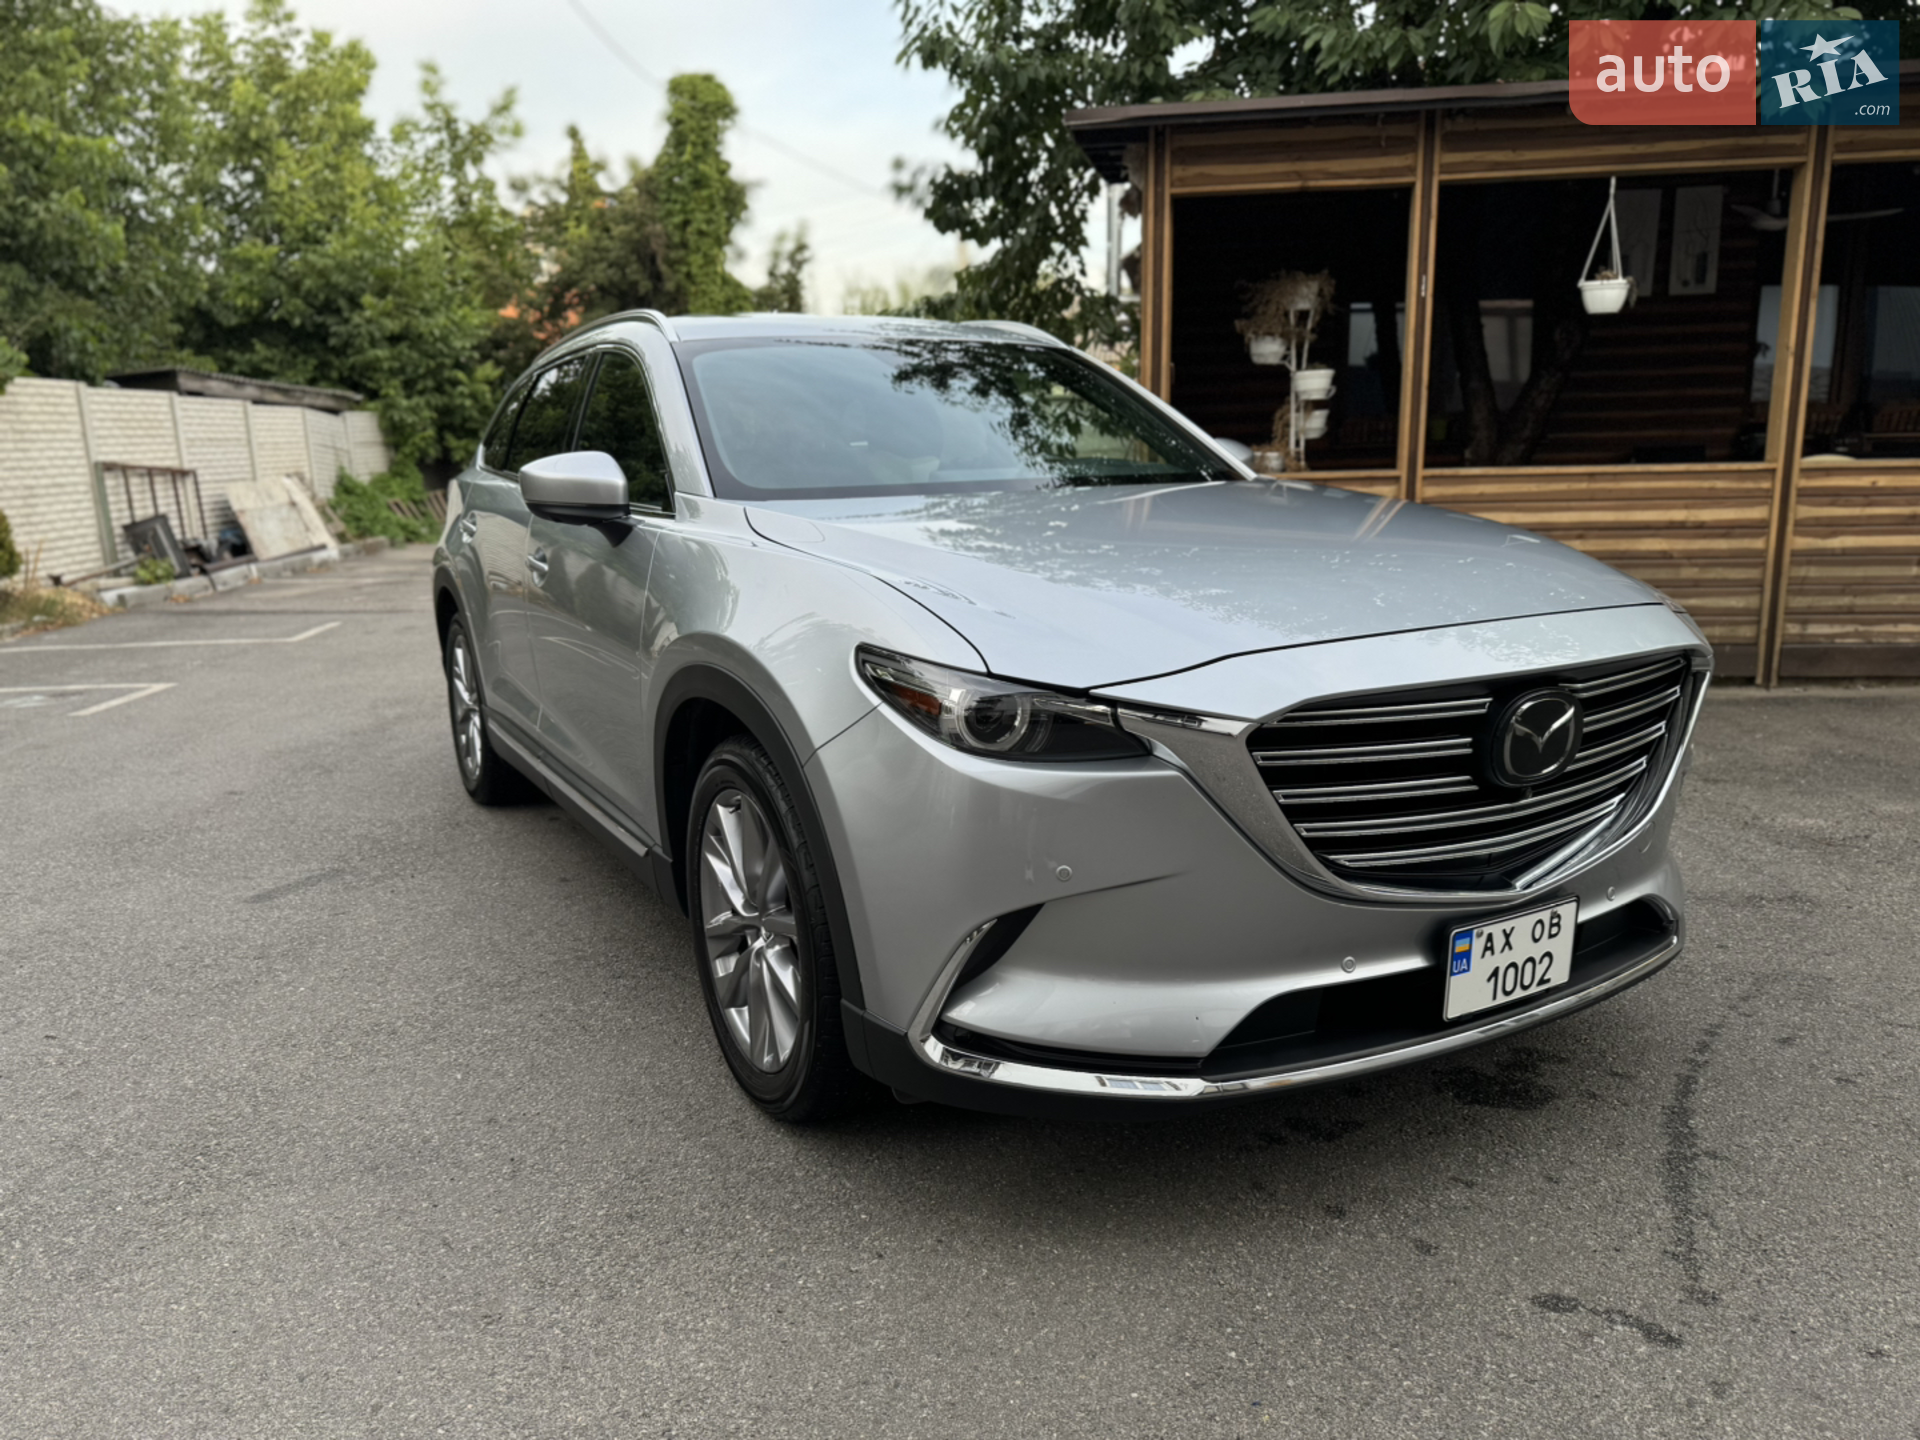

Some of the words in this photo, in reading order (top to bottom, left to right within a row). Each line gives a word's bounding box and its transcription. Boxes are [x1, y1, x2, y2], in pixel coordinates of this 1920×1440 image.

[1480, 926, 1516, 959] AX
[1531, 913, 1562, 943] OB
[1452, 958, 1469, 974] UA
[1486, 951, 1554, 1001] 1002
